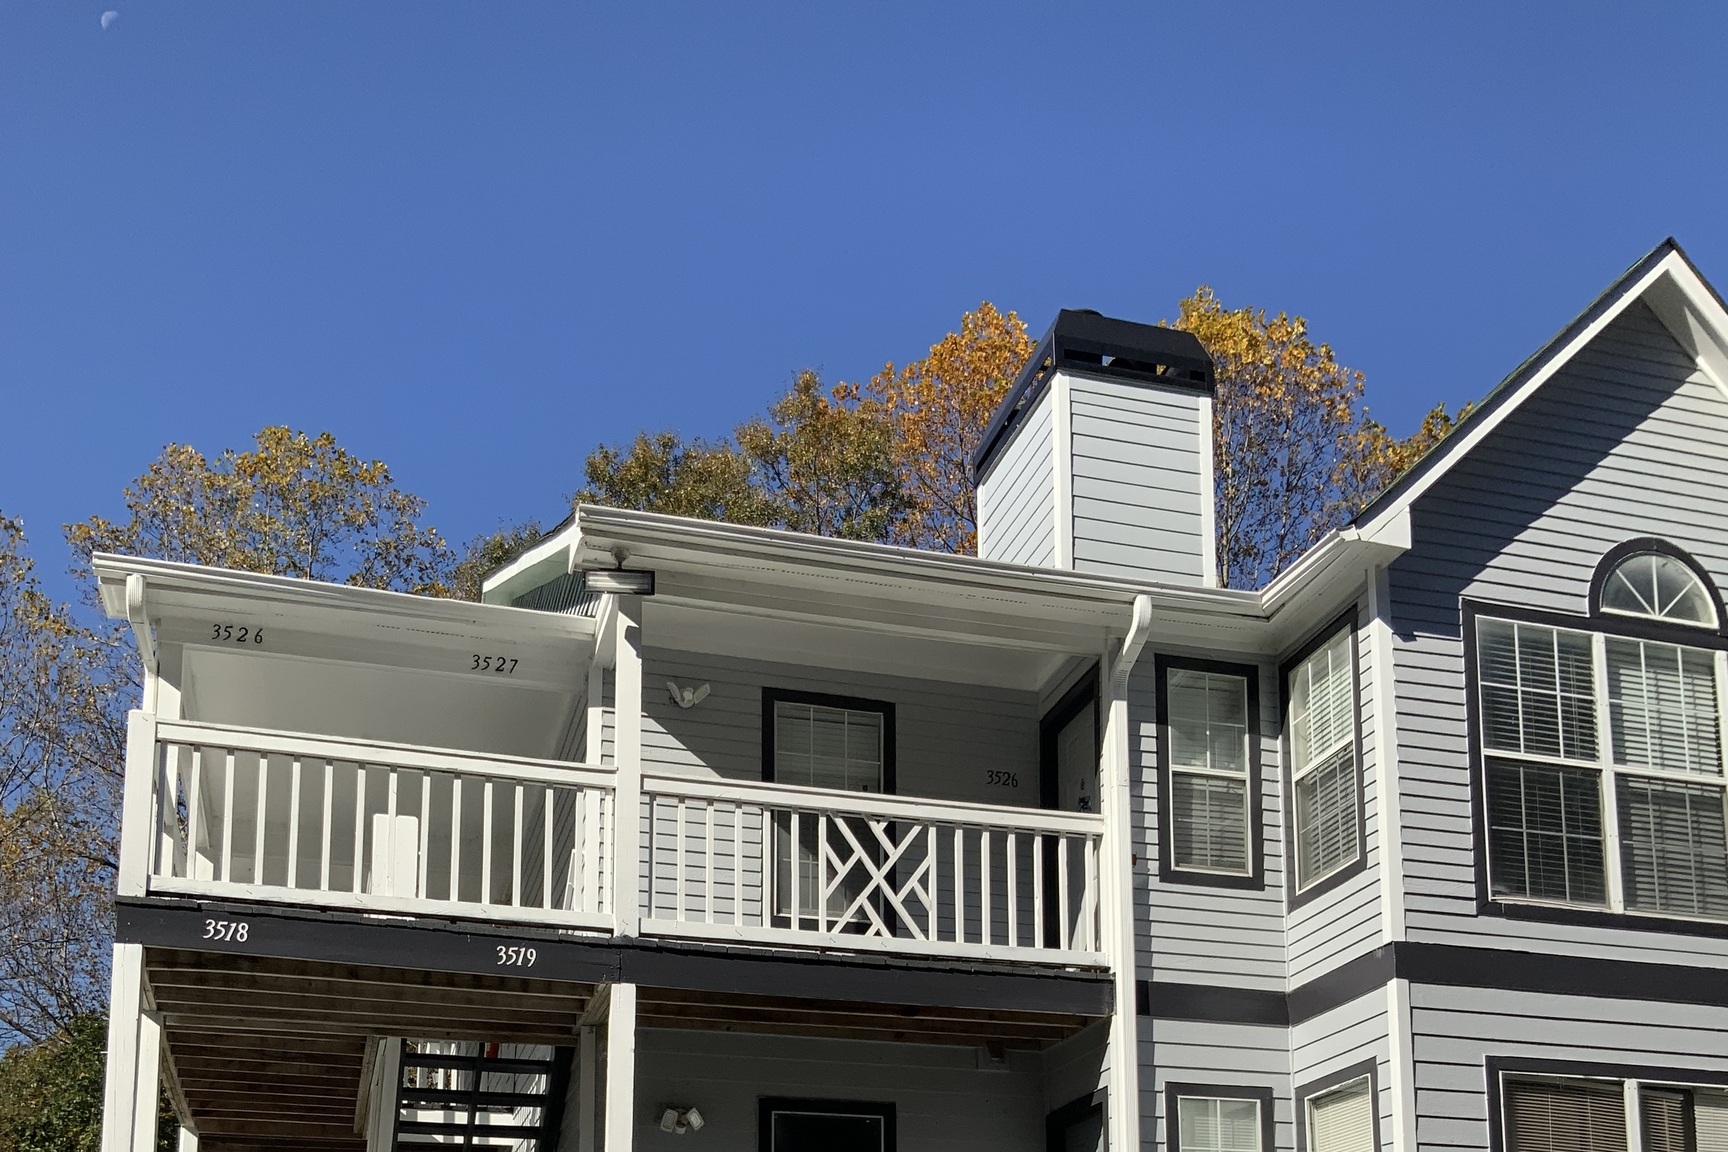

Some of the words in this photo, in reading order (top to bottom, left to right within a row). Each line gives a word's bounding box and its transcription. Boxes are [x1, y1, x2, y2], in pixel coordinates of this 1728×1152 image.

[211, 623, 264, 645] 3526
[471, 654, 519, 675] 3527
[986, 769, 1019, 788] 3526
[202, 919, 250, 943] 3518
[496, 945, 537, 968] 3519
